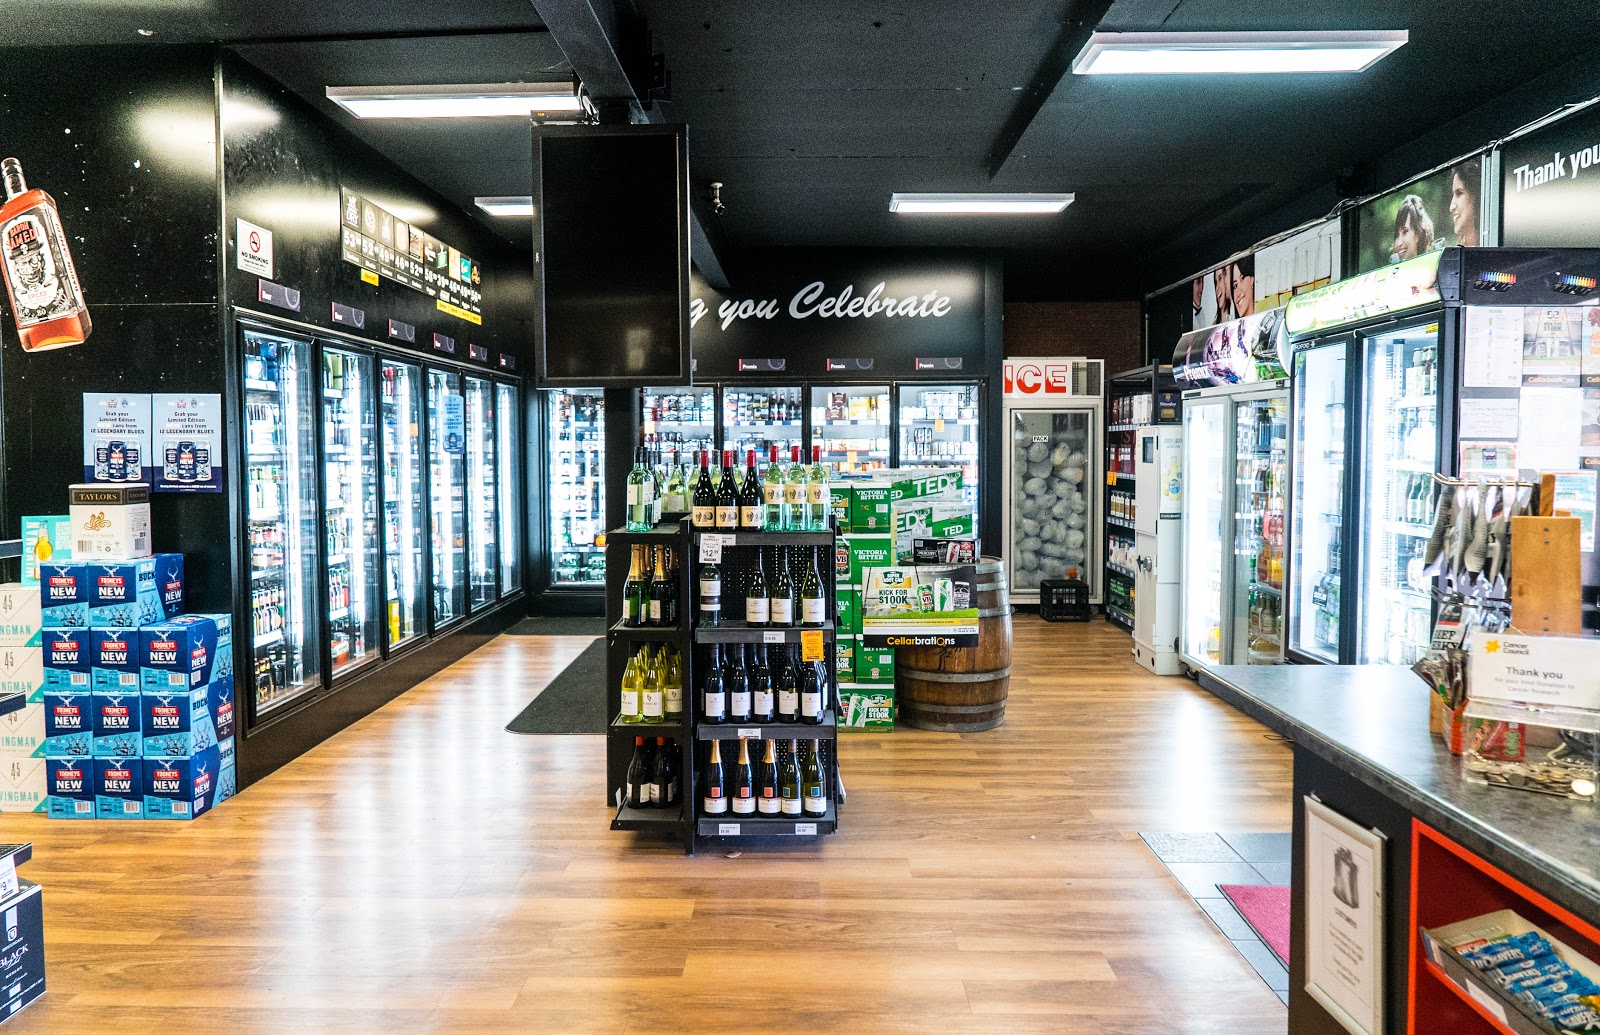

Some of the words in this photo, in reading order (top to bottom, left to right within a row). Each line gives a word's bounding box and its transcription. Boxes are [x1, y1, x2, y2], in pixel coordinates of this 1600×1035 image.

[1513, 151, 1566, 193] Thank
[1569, 143, 1600, 180] you
[9, 220, 29, 237] BARON
[248, 253, 269, 265] SMOKING
[718, 298, 779, 331] you
[788, 281, 952, 320] Celebrate
[1004, 364, 1068, 394] ICE
[1183, 365, 1211, 382] Premix
[912, 475, 949, 497] TED
[942, 525, 964, 536] TED
[836, 556, 847, 564] VB
[138, 572, 156, 581] BUCK
[50, 586, 77, 596] NEW
[98, 586, 126, 596] NEW
[165, 590, 182, 601] NEW
[879, 595, 908, 605] $100K
[217, 627, 231, 638] BUCK
[886, 636, 956, 647] Cellarbrations
[52, 651, 79, 661] NEW
[100, 651, 127, 661] NEW
[150, 651, 177, 661] NEW
[191, 655, 207, 668] NEW
[1505, 666, 1540, 677] Thank
[1542, 671, 1564, 680] you
[1531, 687, 1561, 696] Research
[192, 699, 208, 711] BUCK
[54, 716, 81, 726] NEW
[102, 716, 129, 726] NEW
[153, 716, 180, 726] NEW
[217, 711, 232, 725] NEW
[219, 748, 234, 760] BUCK
[10, 761, 21, 781] 45
[56, 780, 83, 789] NEW
[104, 780, 131, 789] NEW
[153, 780, 180, 789] NEW
[194, 780, 210, 794] NEW
[0, 943, 29, 969] BLACK
